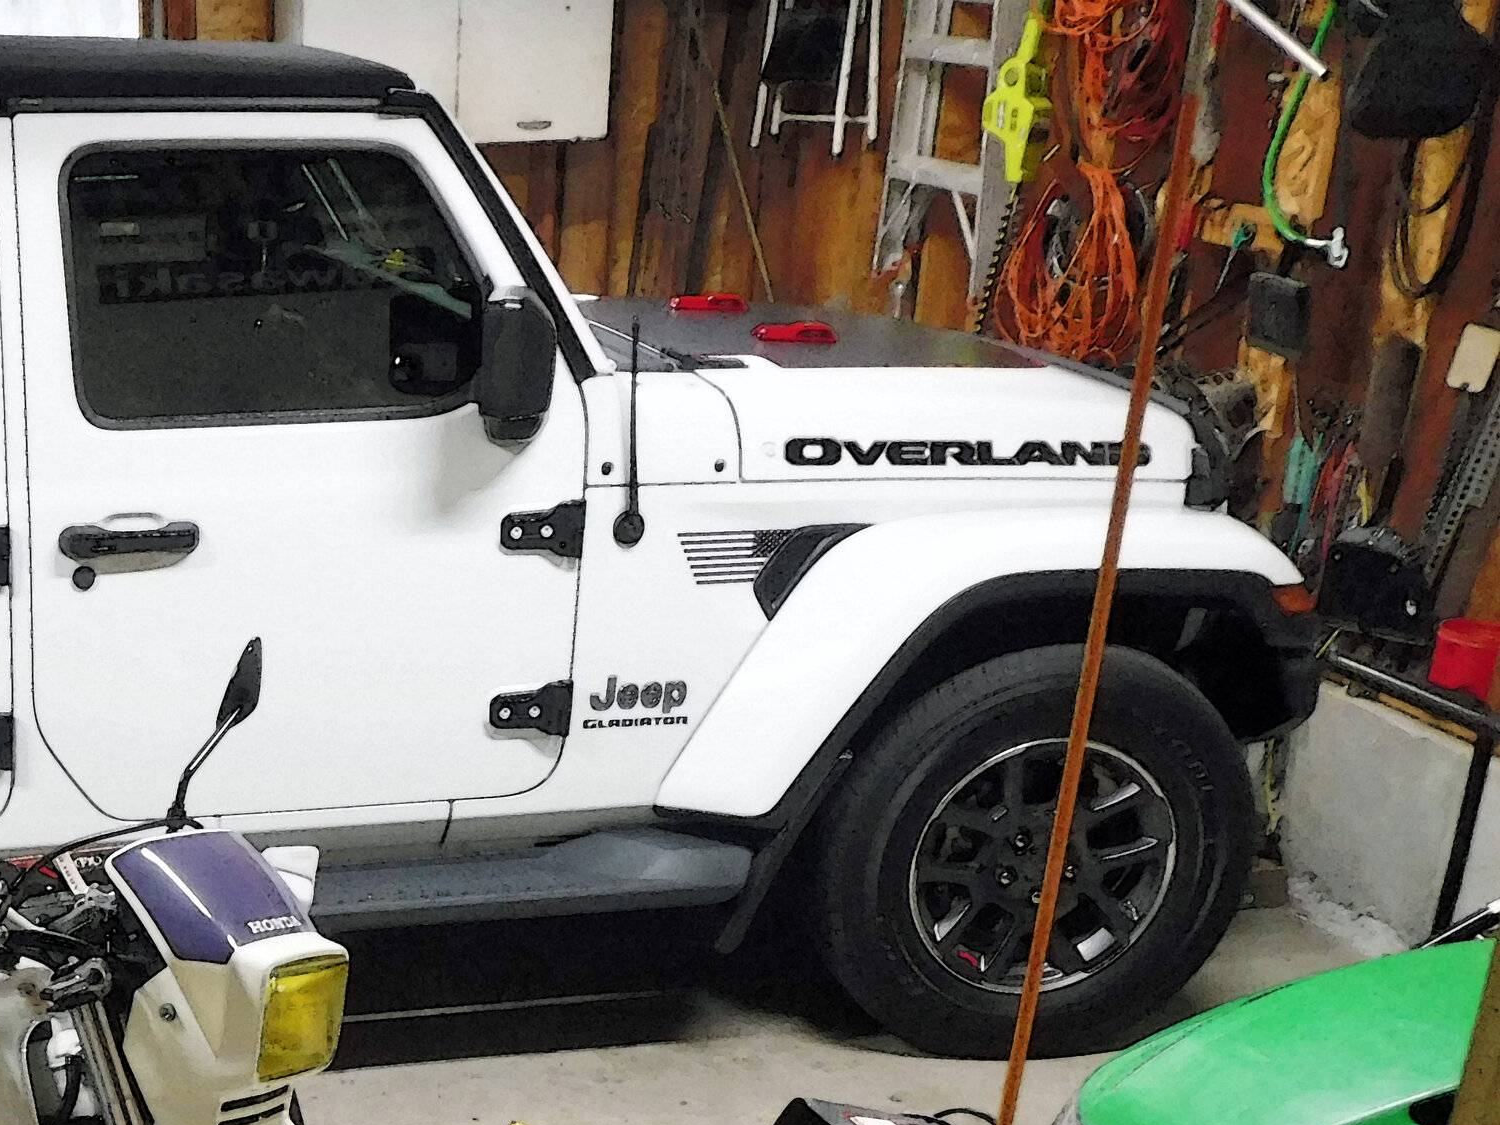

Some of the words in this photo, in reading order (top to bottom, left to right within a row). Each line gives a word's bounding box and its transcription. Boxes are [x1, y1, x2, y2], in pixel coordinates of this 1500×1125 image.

[784, 437, 1152, 466] OVERLAND
[589, 676, 687, 714] Jeep
[582, 716, 688, 729] GLADIATOR
[247, 915, 302, 935] HONDA
